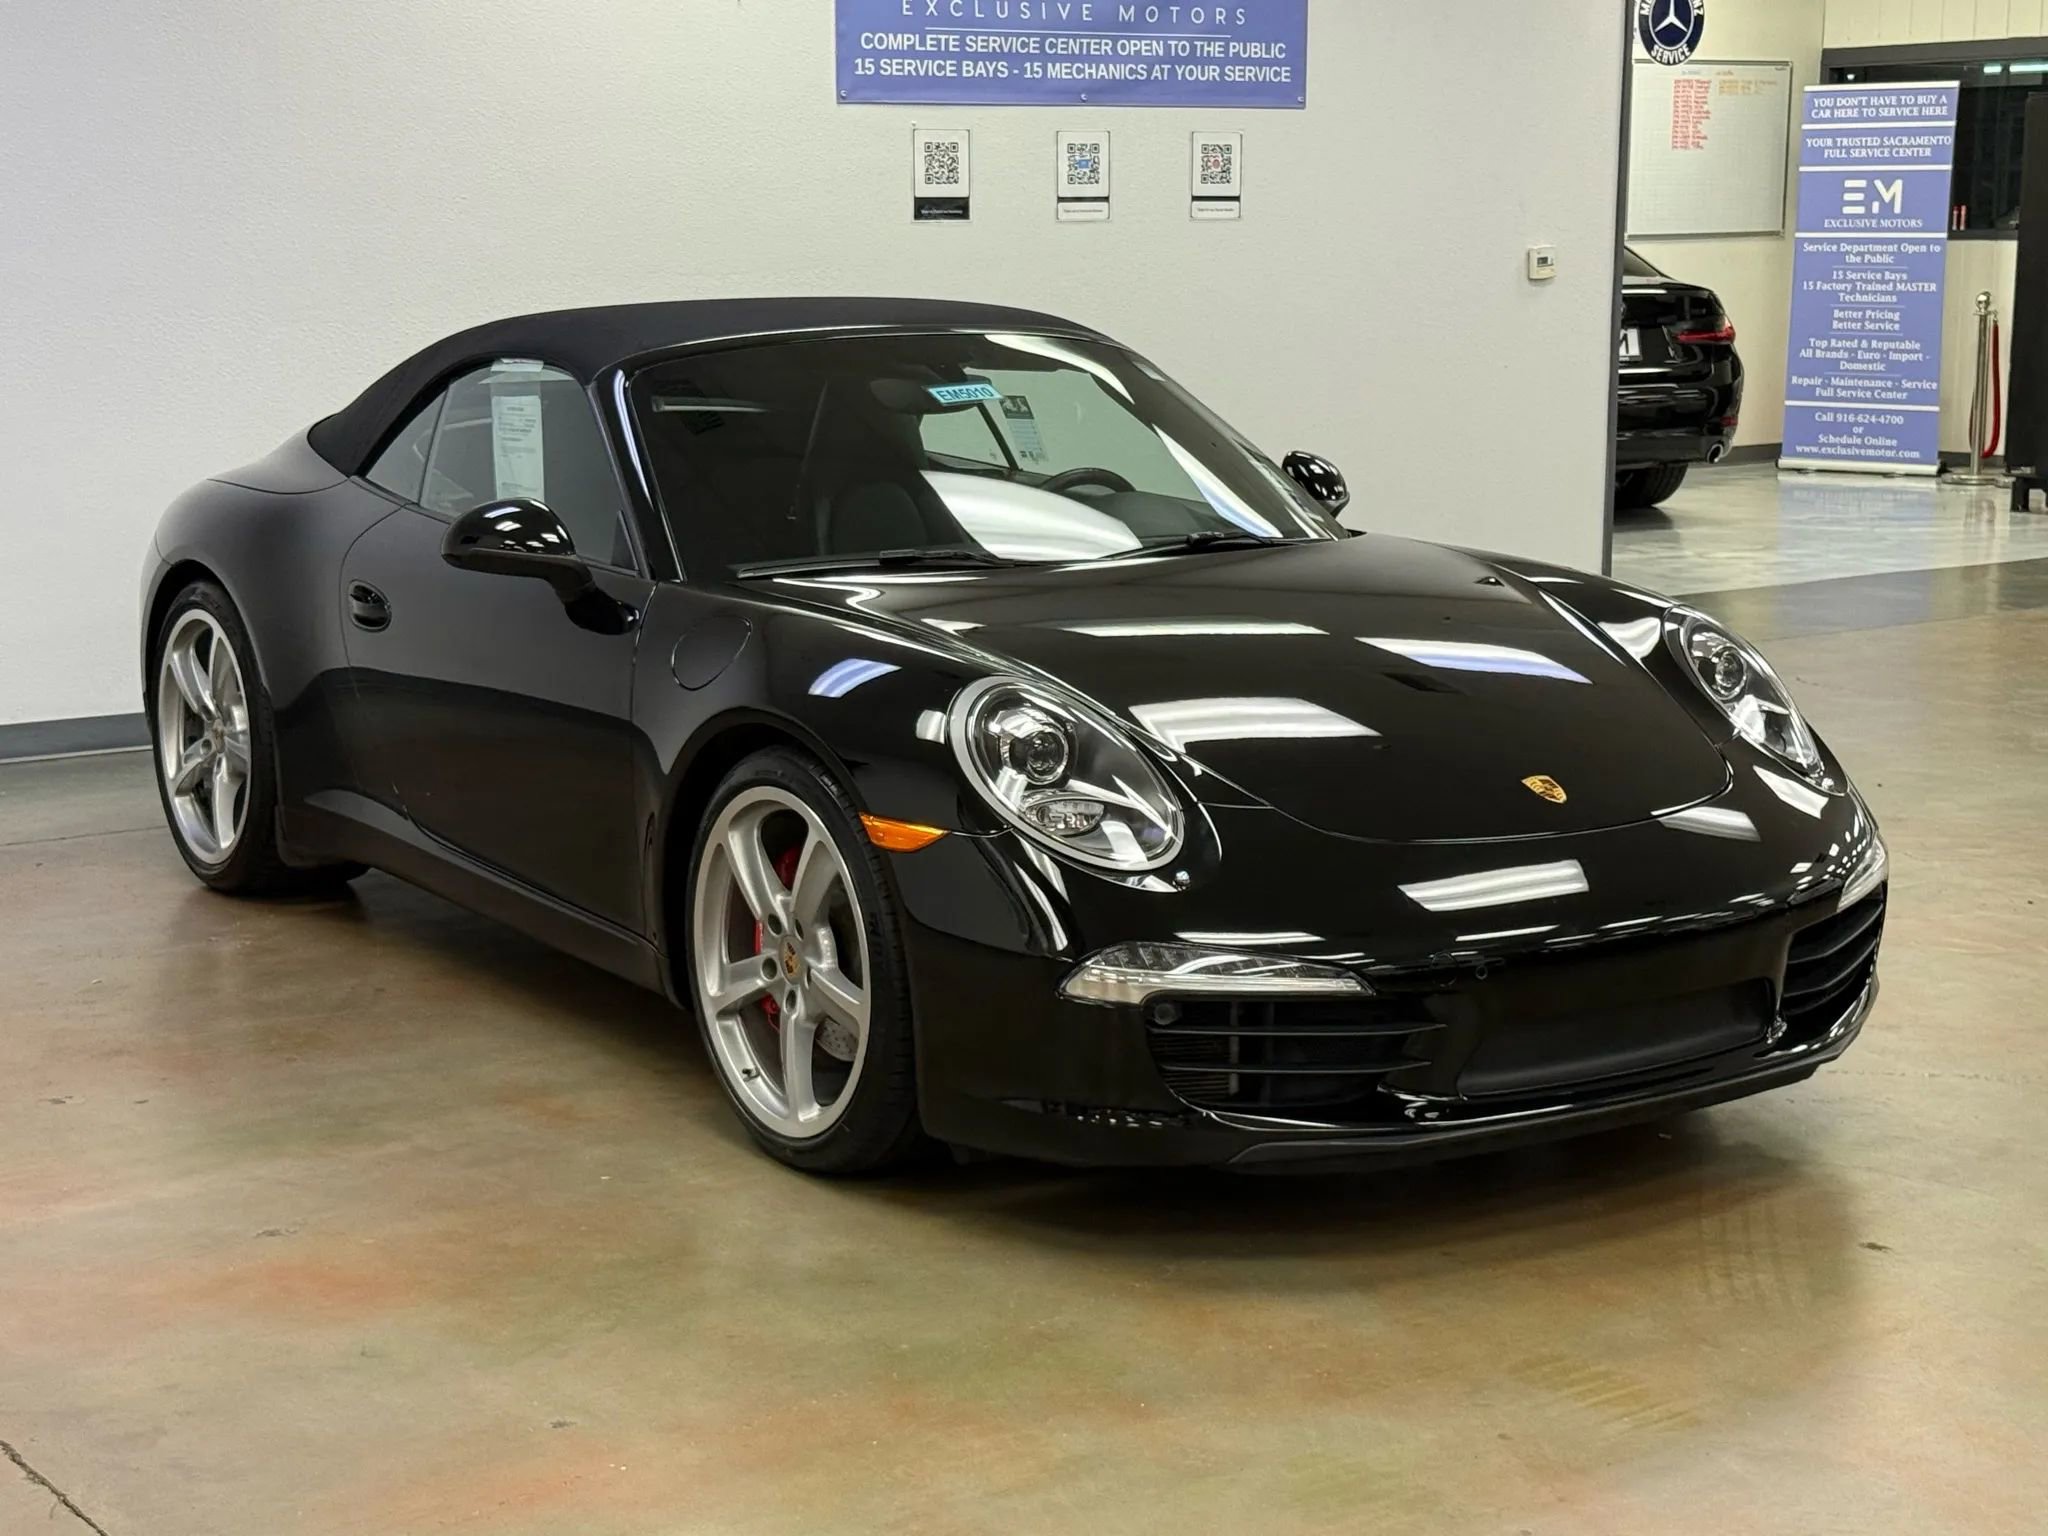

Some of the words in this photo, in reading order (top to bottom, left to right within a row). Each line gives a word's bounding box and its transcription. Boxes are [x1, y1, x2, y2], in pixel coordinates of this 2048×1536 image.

[902, 0, 1093, 21] EXCLUSIVE
[1118, 5, 1246, 25] MOTORS
[860, 32, 960, 51] COMPLETE
[965, 35, 1040, 54] SERVICE
[1045, 37, 1112, 56] CENTER
[1117, 39, 1164, 57] OPEN
[1168, 40, 1190, 57] TO
[1194, 41, 1225, 58] THE
[1229, 42, 1286, 59] PUBLIC
[1650, 43, 1691, 64] SERVICE
[854, 58, 875, 75] 15
[879, 59, 957, 77] SERVICE
[962, 60, 1009, 78] BAYS
[1024, 62, 1042, 79] 15
[1047, 62, 1147, 81] MECHANICS
[1151, 64, 1171, 80] AT
[1175, 65, 1220, 81] YOUR
[1224, 66, 1291, 82] SERVICE
[1813, 98, 1834, 107] YOU
[1836, 97, 1868, 107] DON'T
[1870, 96, 1898, 106] HAVE
[1900, 96, 1915, 105] TO
[1918, 95, 1938, 105] BUY
[1939, 95, 1948, 104] A
[1811, 109, 1831, 119] CAR
[1834, 108, 1859, 118] HERE
[1862, 108, 1876, 118] TO
[1878, 107, 1919, 117] SERVICE
[1921, 106, 1948, 116] HERE
[1806, 138, 1833, 148] YOUR
[1836, 137, 1880, 147] TRUSTED
[1882, 136, 1951, 146] SACRAMENTO
[1824, 149, 1848, 158] FULL
[1850, 148, 1890, 158] SERVICE
[1892, 148, 1931, 157] CENTER
[1842, 179, 1903, 214] EM
[1824, 218, 1878, 228] EXCLUSIVE
[1880, 218, 1923, 228] MOTORS
[1803, 242, 1838, 252] Service
[1840, 243, 1898, 254] Department
[1900, 243, 1927, 254] Open
[1930, 244, 1941, 253] to
[1845, 254, 1861, 264] the
[1864, 254, 1894, 264] Public
[1832, 270, 1844, 280] 15
[1845, 270, 1882, 280] Service
[1884, 271, 1908, 281] Bays
[1803, 281, 1814, 290] 15
[1816, 281, 1852, 292] Factory
[1855, 281, 1893, 292] Trained
[1896, 282, 1937, 292] MASTER
[1838, 292, 1897, 303] Technicians
[1833, 310, 1862, 319] Better
[1865, 310, 1900, 321] Pricing
[1832, 320, 1861, 330] Better
[1864, 321, 1900, 331] Service
[1808, 338, 1828, 348] Top
[1830, 338, 1858, 348] Rated
[1860, 340, 1868, 348] &
[1871, 340, 1921, 350] Reputable
[1800, 349, 1813, 358] All
[1815, 350, 1849, 359] Brands
[1857, 351, 1880, 360] Euro
[1888, 351, 1924, 362] Import
[1840, 361, 1886, 371] Domestic
[1792, 376, 1822, 387] Repair
[1830, 377, 1892, 388] Maintenance
[1901, 380, 1938, 390] Service
[936, 387, 993, 401] EM5010
[1816, 388, 1834, 397] Full
[1836, 388, 1872, 398] Service
[1874, 390, 1908, 400] Center
[1815, 412, 1834, 422] Call
[1836, 413, 1904, 425] 916-624-4700
[1818, 434, 1862, 445] Schedule
[1864, 436, 1898, 446] Online
[1795, 445, 1920, 458] www.exclusivemotor.com
